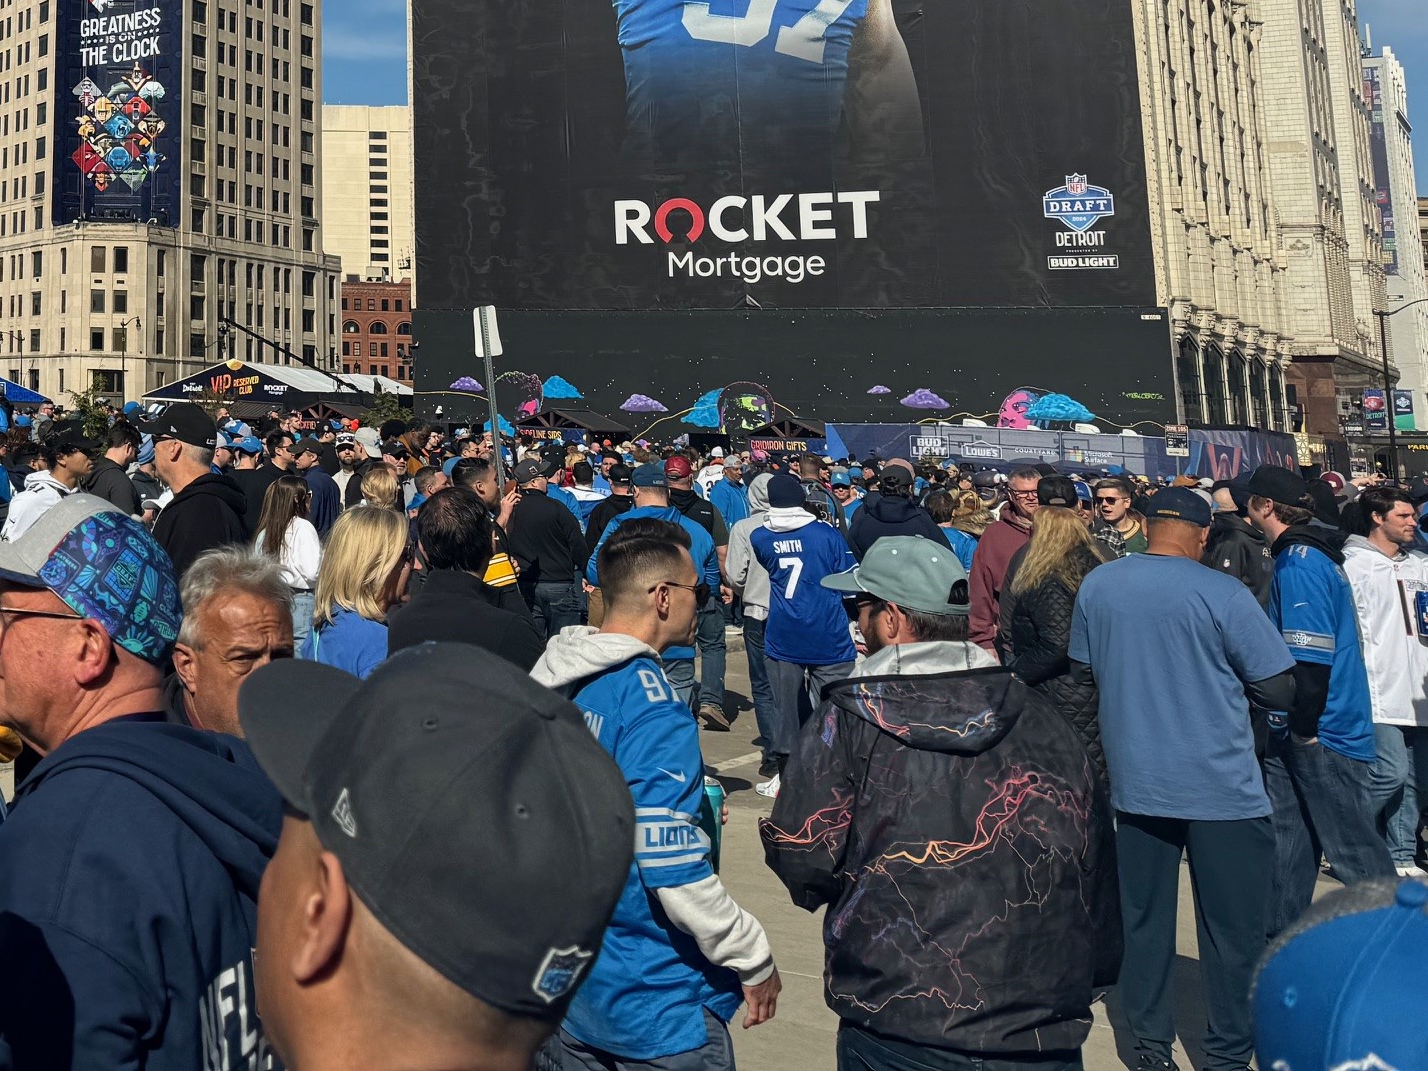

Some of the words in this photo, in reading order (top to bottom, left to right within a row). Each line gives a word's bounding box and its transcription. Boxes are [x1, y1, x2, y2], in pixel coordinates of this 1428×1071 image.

[80, 7, 161, 37] GREATNESS
[105, 35, 116, 44] IS
[119, 31, 136, 42] ON
[80, 45, 108, 67] THE
[112, 35, 161, 63] CLOCK
[1069, 183, 1085, 193] NFL
[1049, 199, 1108, 212] DRAFT
[614, 190, 880, 245] ROCKET
[1055, 230, 1106, 247] DETROIT
[668, 251, 826, 284] Mortgage
[1050, 257, 1077, 267] BUD
[1079, 257, 1116, 267] LIGHT
[211, 374, 232, 393] VIP
[239, 385, 253, 395] CLUB
[547, 430, 562, 440] SIPS
[917, 437, 942, 447] BUD
[750, 440, 784, 450] GRIDIRON
[786, 441, 807, 452] GIFTS
[912, 446, 947, 457] LIGHT
[965, 446, 999, 458] LOWE'S
[773, 539, 803, 554] SMITH
[778, 557, 804, 599] 7
[644, 825, 701, 848] LIONS
[199, 960, 258, 1071] NFL
